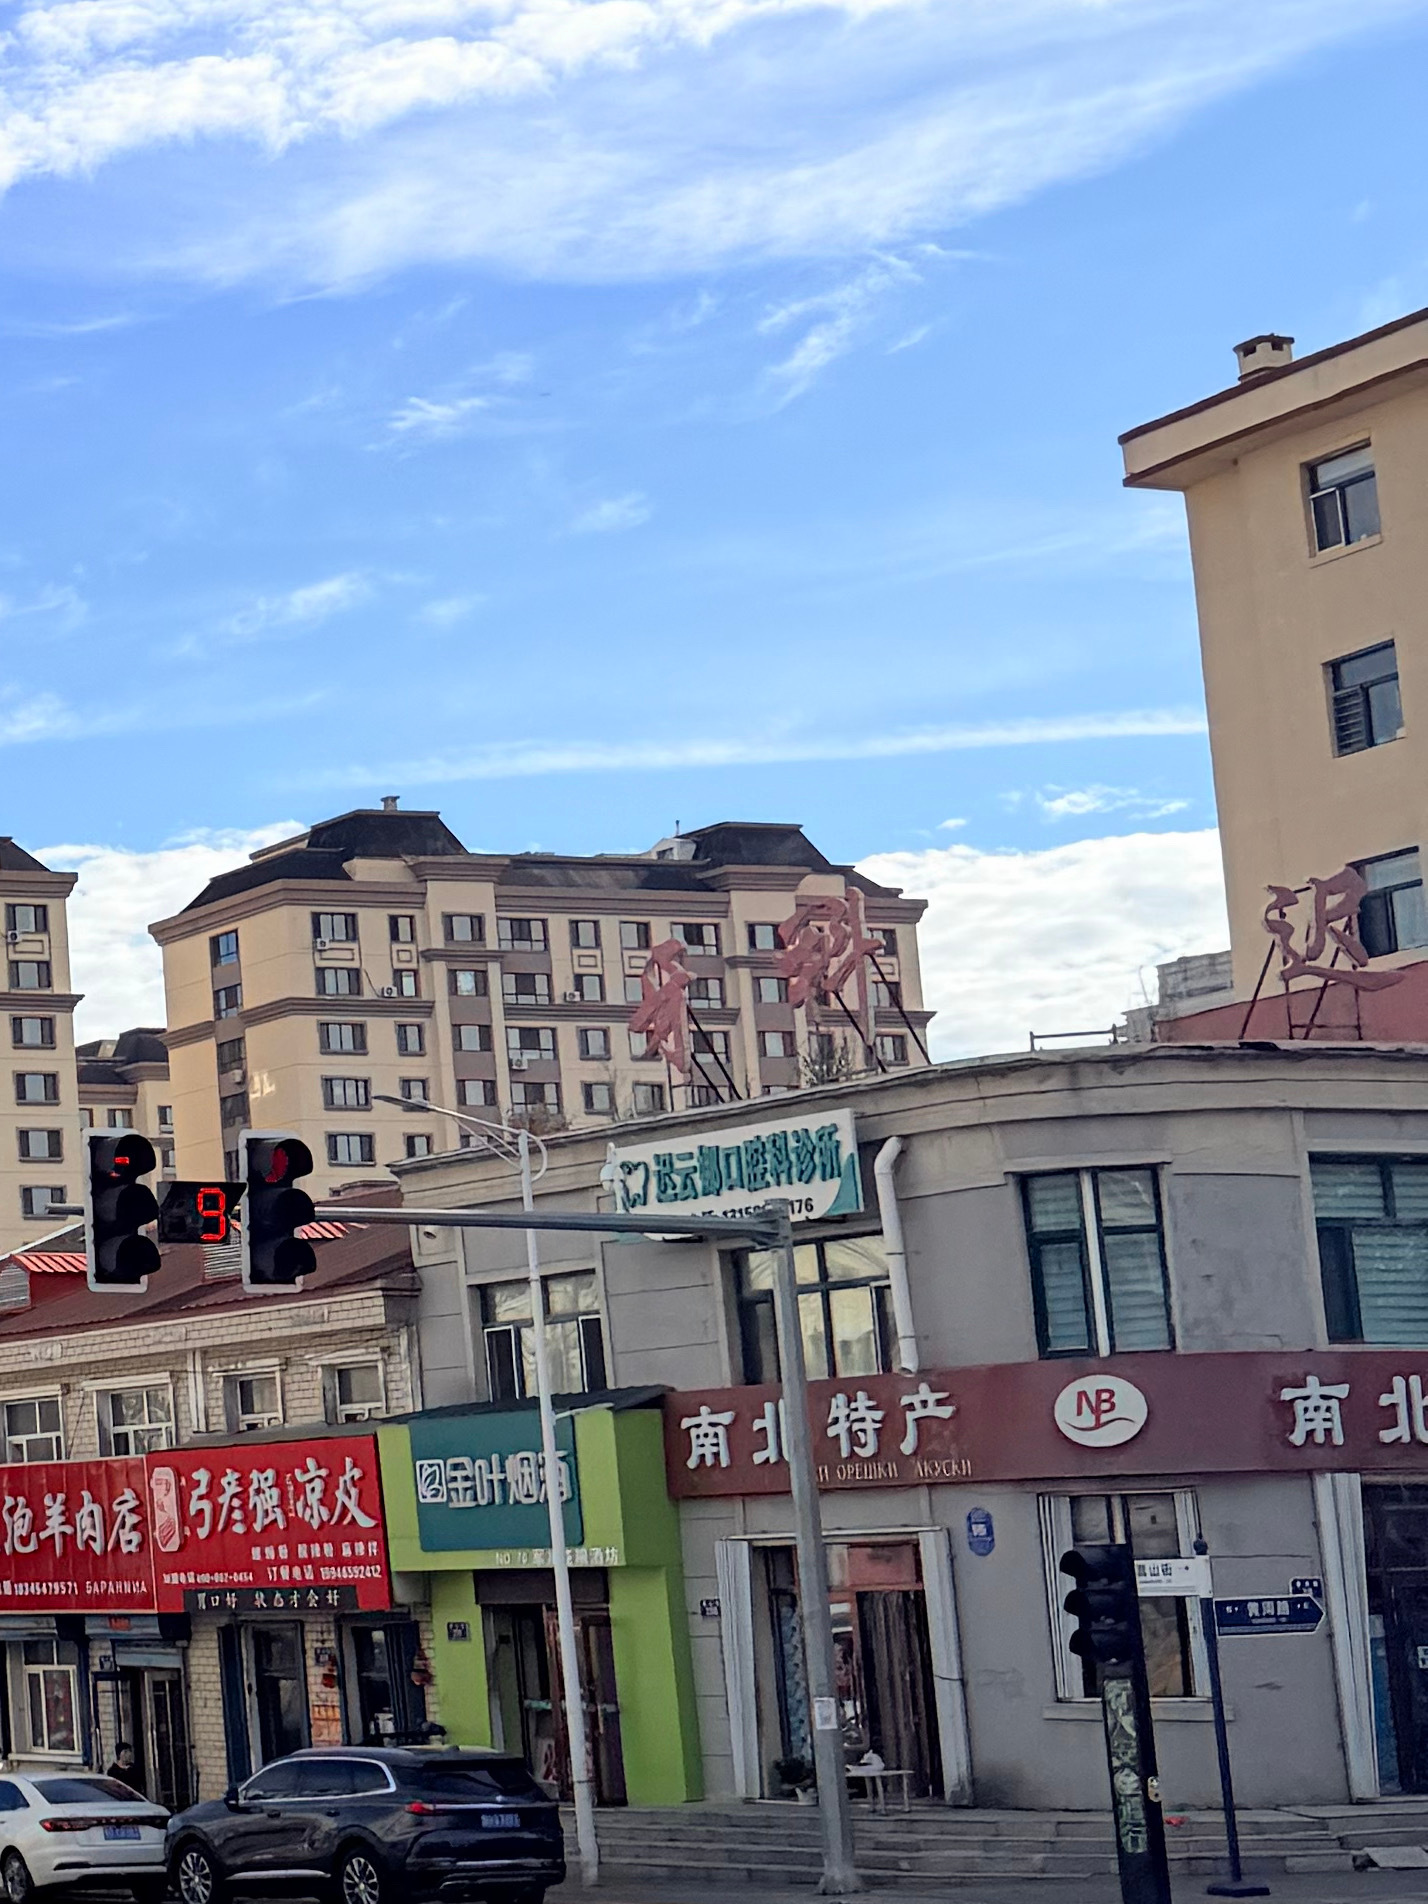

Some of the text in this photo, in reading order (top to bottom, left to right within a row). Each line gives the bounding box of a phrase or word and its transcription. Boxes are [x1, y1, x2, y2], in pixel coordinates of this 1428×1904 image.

[197, 1187, 226, 1243] 9
[680, 1382, 957, 1470] 南北特产
